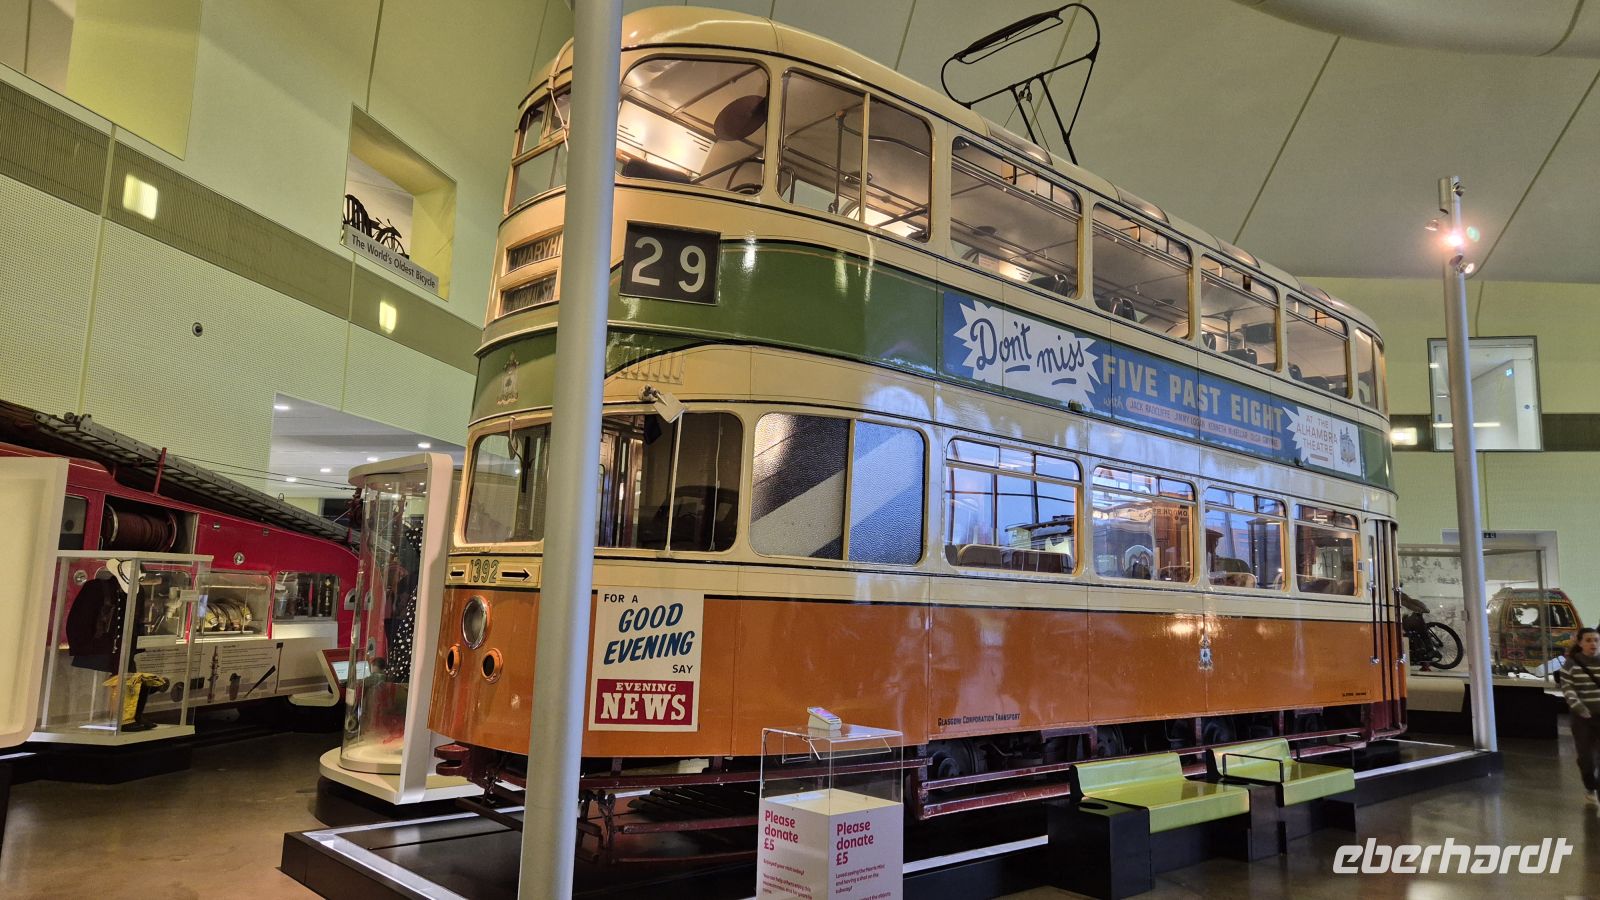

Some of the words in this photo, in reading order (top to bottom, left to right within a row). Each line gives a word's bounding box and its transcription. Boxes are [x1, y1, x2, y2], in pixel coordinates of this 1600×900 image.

[351, 234, 365, 250] The
[367, 243, 393, 265] World's
[393, 258, 414, 277] Oldest
[415, 270, 436, 288] Bicycle
[631, 236, 707, 293] 29
[970, 317, 1032, 371] Don't
[1037, 334, 1085, 374] miss
[1102, 354, 1158, 398] FIVE
[1169, 374, 1221, 415] PAST
[1230, 393, 1285, 433] EIGHT
[1129, 399, 1144, 412] JACK
[1306, 415, 1313, 423] AT
[1318, 418, 1329, 429] THE
[1296, 423, 1338, 445] ALHAMBRA
[1302, 437, 1333, 453] THEATRE
[469, 558, 500, 583] 1392
[603, 593, 625, 603] FOR
[631, 594, 639, 604] A
[618, 602, 684, 633] GOOD
[603, 630, 696, 665] EVENING
[672, 664, 694, 674] SAY
[615, 682, 677, 692] EVENING
[600, 692, 687, 721] NEWS
[764, 810, 796, 828] Please
[764, 824, 799, 843] donate
[836, 821, 871, 836] Please
[763, 838, 775, 851] £5
[836, 833, 874, 851] donate
[836, 851, 848, 866] £5
